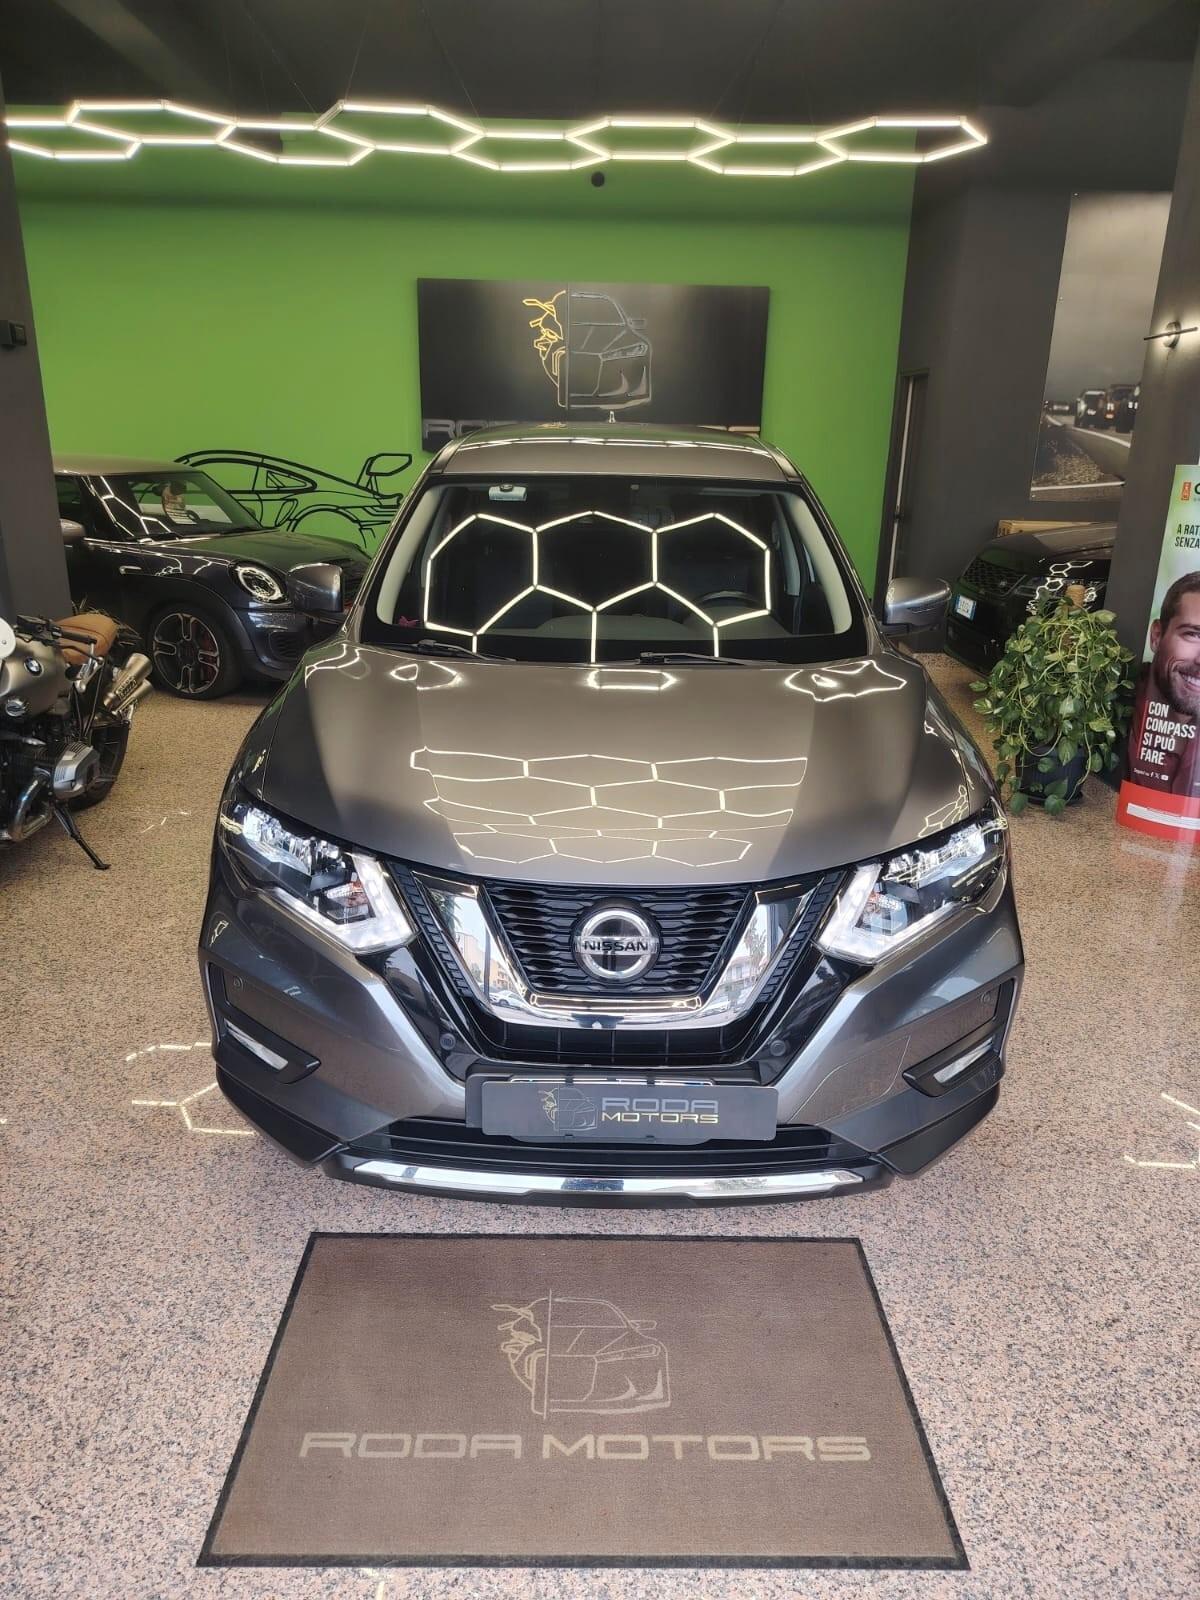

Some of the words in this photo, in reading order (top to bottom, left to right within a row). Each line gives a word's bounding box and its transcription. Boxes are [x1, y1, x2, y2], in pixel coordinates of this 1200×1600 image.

[1176, 523, 1182, 535] A
[1174, 536, 1200, 549] SENZA
[1148, 701, 1169, 718] CON
[1145, 717, 1196, 739] COMPASS
[1142, 732, 1153, 746] SI
[1154, 735, 1176, 752] PUÒ
[1140, 747, 1165, 766] FARE
[583, 940, 649, 952] NISSAN
[601, 1097, 719, 1113] RODA
[601, 1112, 719, 1124] MOTORS
[299, 1432, 523, 1459] RODA
[542, 1434, 872, 1461] MOTORS
